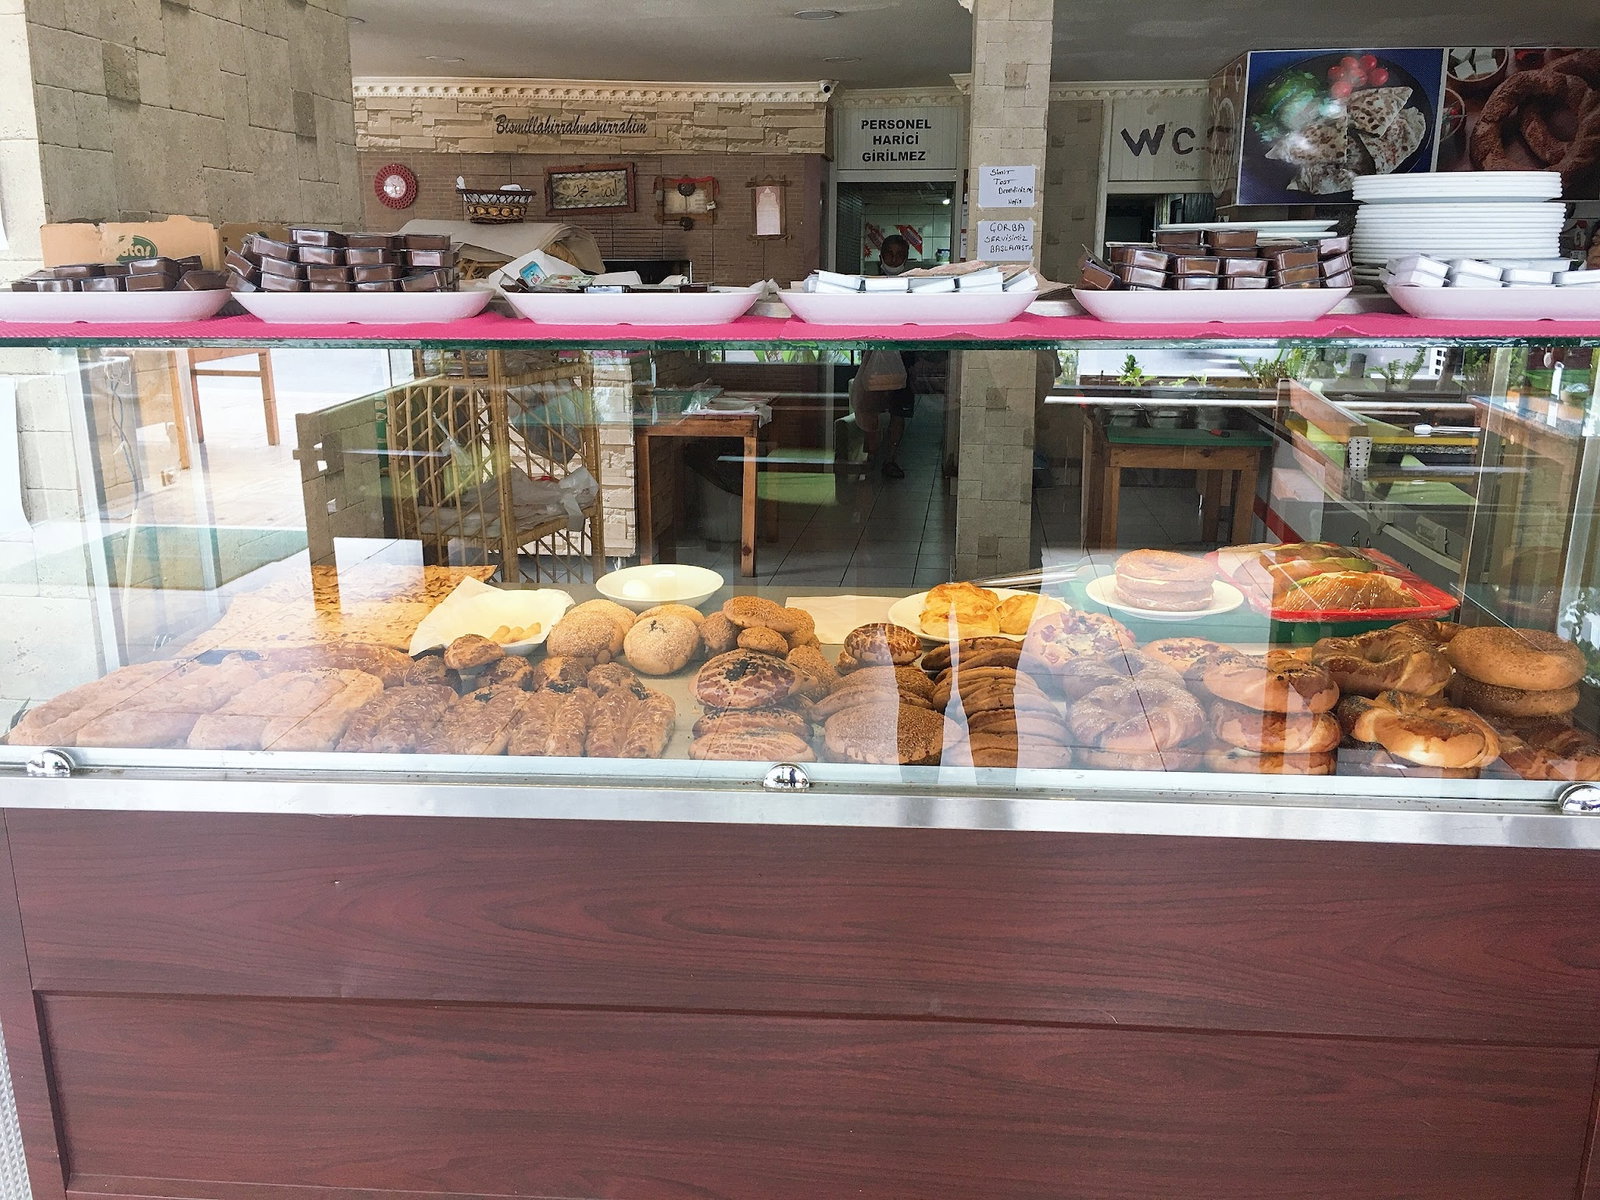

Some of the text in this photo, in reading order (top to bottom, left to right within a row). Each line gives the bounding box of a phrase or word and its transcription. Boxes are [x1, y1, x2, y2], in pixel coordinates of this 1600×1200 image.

[861, 119, 932, 130] PERSONEL
[873, 132, 919, 145] HARİCİ
[1120, 123, 1196, 157] WC
[862, 149, 926, 162] GİRİLMEZ
[989, 222, 1025, 233] ÇORBA
